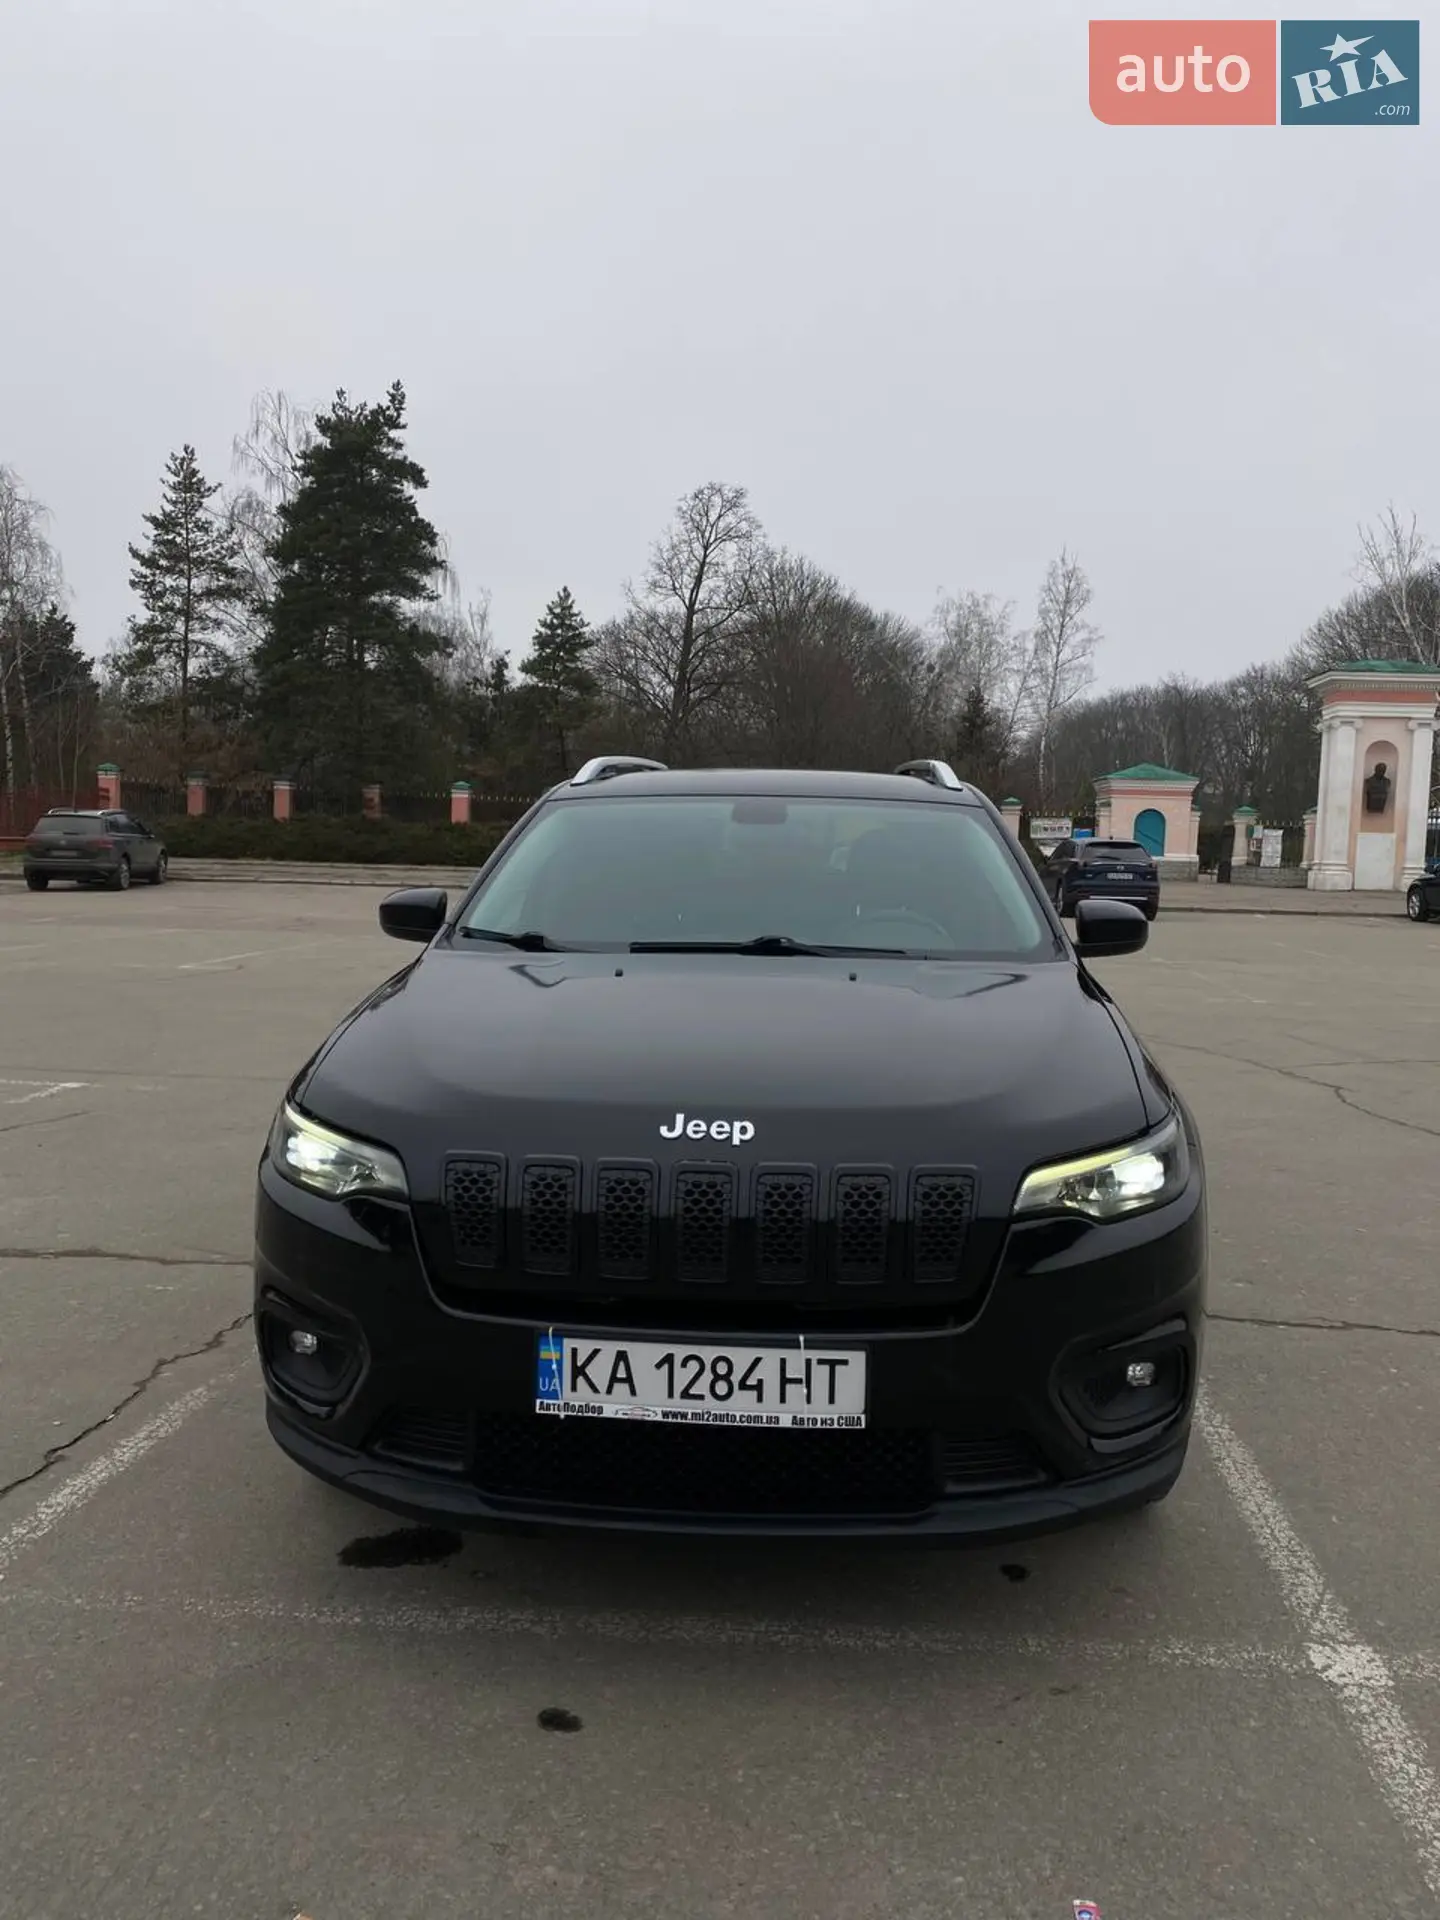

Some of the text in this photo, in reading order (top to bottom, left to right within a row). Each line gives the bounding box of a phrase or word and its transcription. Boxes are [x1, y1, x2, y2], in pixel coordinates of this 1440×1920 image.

[659, 1113, 755, 1145] Jeep
[569, 1347, 637, 1397] KA
[654, 1352, 764, 1403] 1284
[539, 1377, 560, 1391] UA
[661, 1409, 780, 1426] www.mi2auto.com.ua
[791, 1415, 862, 1428] Авто из США
